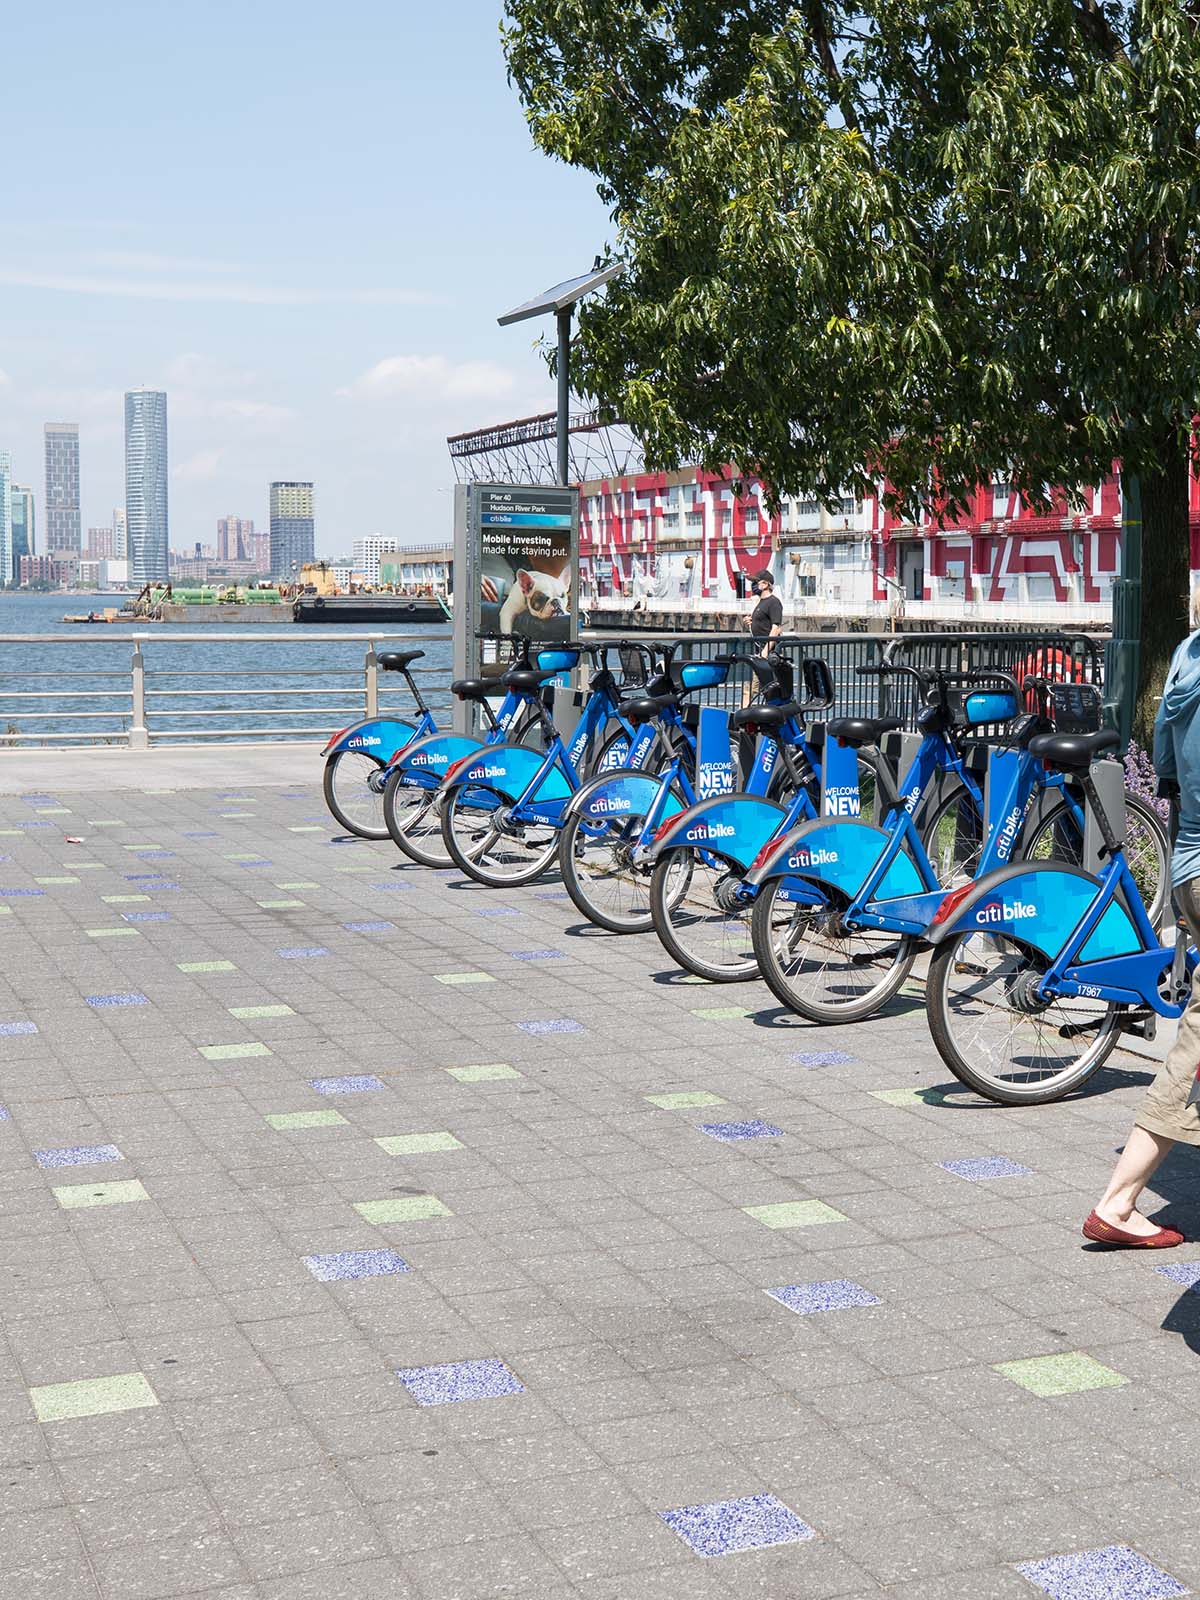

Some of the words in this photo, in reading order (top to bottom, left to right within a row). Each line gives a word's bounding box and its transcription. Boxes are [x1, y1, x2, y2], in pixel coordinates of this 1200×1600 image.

[490, 494, 503, 502] Pier
[503, 494, 512, 502] 40
[532, 505, 546, 513] Park
[482, 534, 511, 544] Mobile
[513, 535, 552, 547] investing
[482, 545, 506, 554] made
[508, 545, 520, 555] for
[521, 547, 551, 557] staying
[552, 547, 568, 558] put.
[700, 762, 732, 771] WELCOME
[700, 771, 733, 788] NEW
[825, 786, 860, 796] WELCOME
[825, 797, 860, 816] NEW
[1077, 984, 1102, 998] 17967
